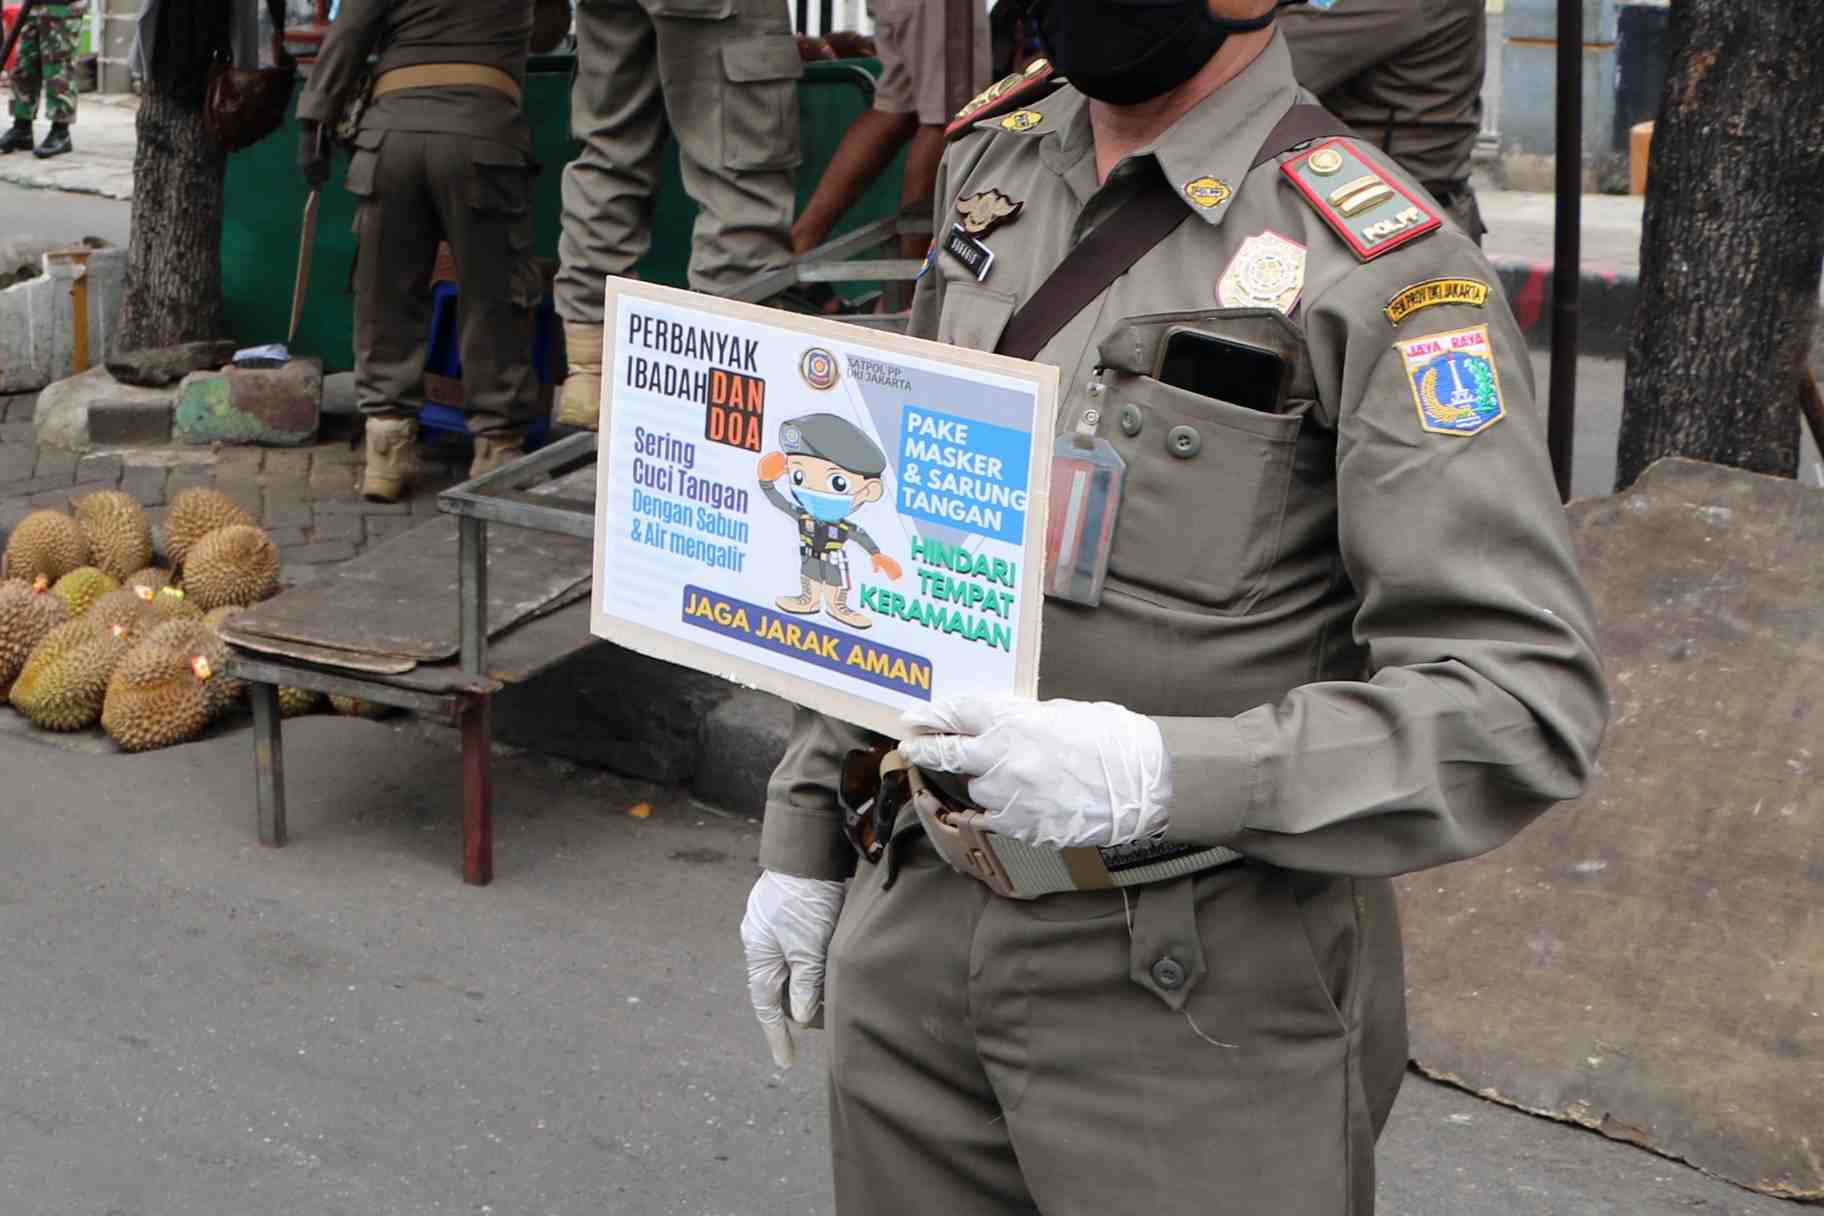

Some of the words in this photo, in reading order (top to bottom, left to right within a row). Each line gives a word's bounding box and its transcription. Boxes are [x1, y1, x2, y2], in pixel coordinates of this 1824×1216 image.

[629, 313, 759, 372] PERBANYAK
[1408, 341, 1441, 357] JAYA
[1450, 333, 1484, 349] RAYA
[627, 355, 707, 405] IBADAH
[712, 370, 764, 415] DAN
[634, 426, 695, 469] Sering
[710, 406, 760, 451] DOA
[907, 412, 969, 445] PAKE
[905, 437, 1003, 481] MASKER
[633, 457, 673, 493] Cuci
[678, 469, 749, 514] Tangan
[902, 487, 1002, 531] TANGAN
[903, 463, 921, 486] &
[928, 469, 1027, 512] SARUNG
[632, 487, 693, 528] Dengan
[696, 506, 749, 544] Sabun
[631, 518, 642, 542] &
[644, 521, 668, 550] Air
[670, 531, 746, 573] mengalir
[911, 535, 1016, 588] HINDARI
[860, 583, 1011, 653] KERAMAIAN
[917, 568, 1014, 620] TEMPAT
[684, 592, 750, 633] JAGA
[755, 615, 840, 660] JARAK
[846, 644, 931, 689] AMAN
